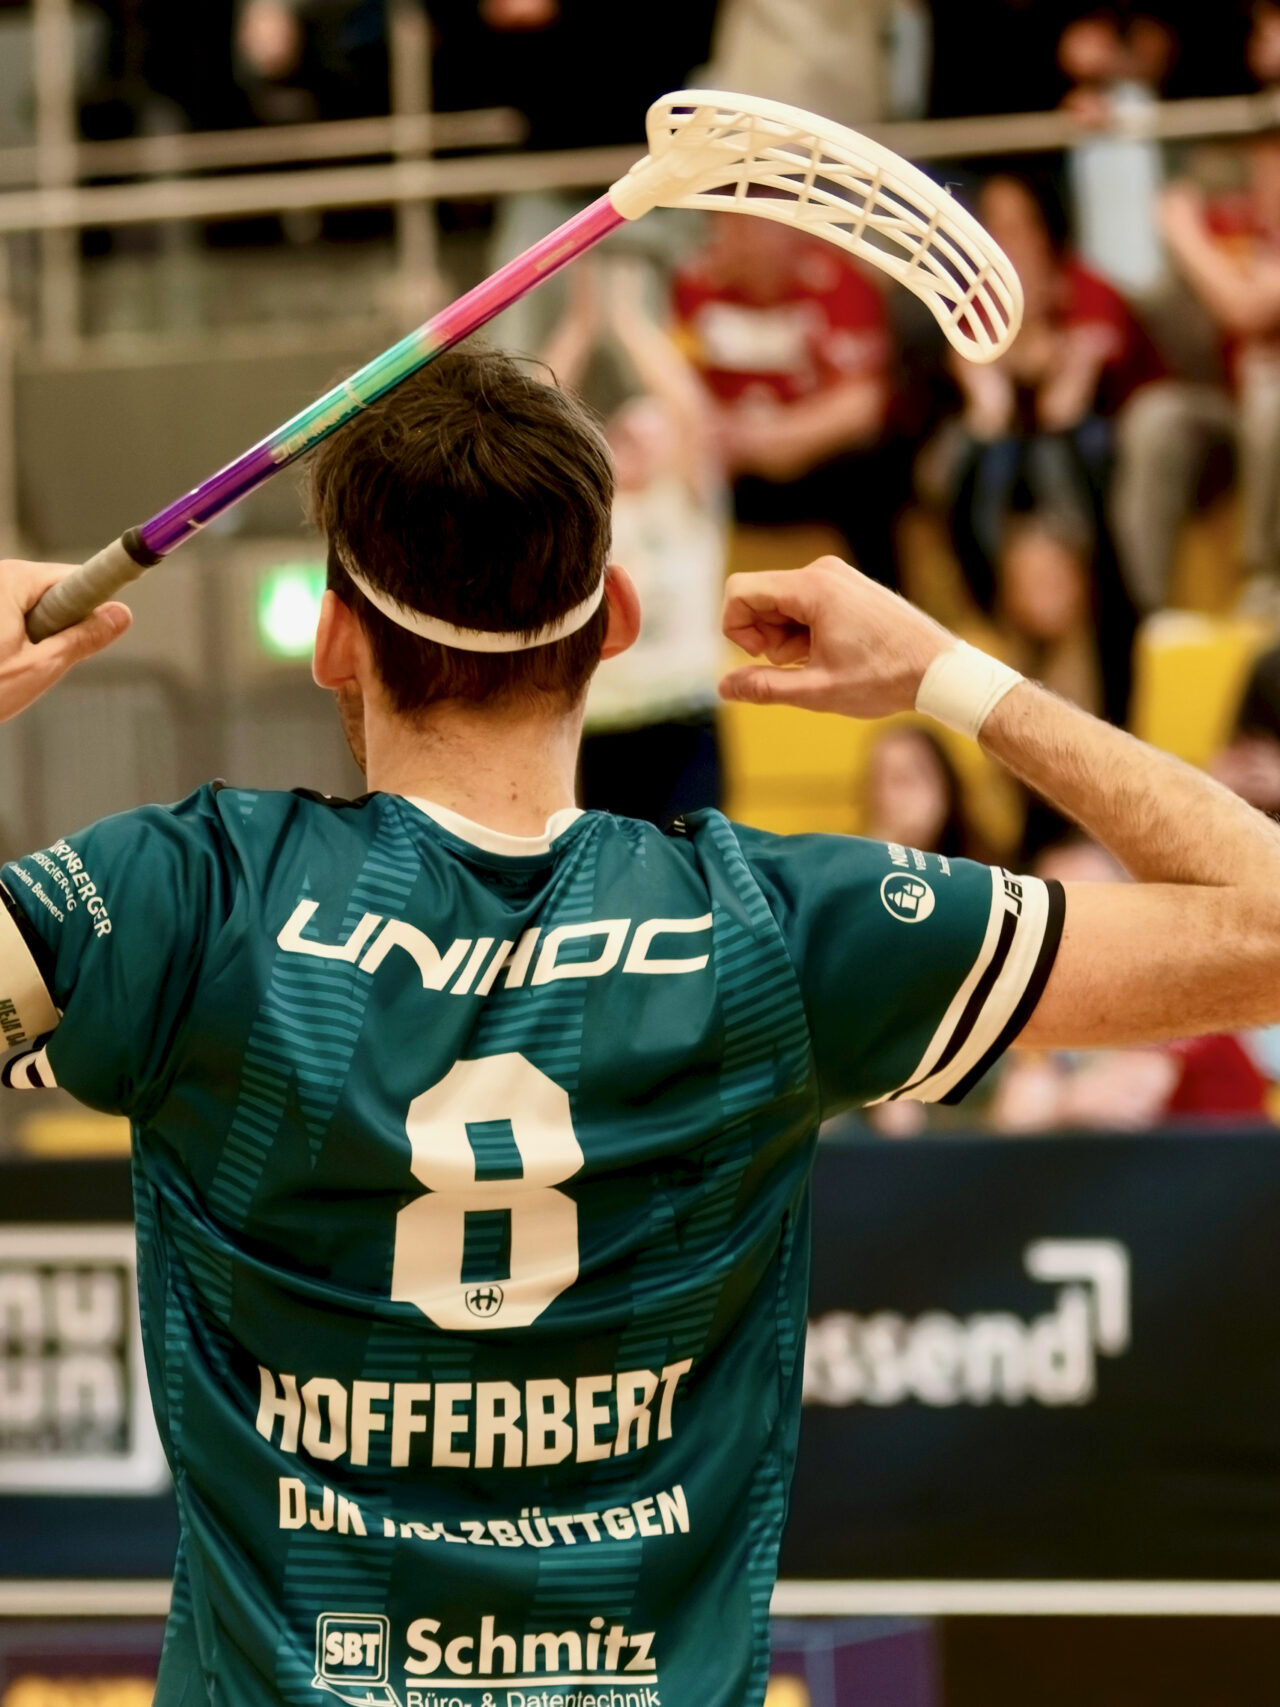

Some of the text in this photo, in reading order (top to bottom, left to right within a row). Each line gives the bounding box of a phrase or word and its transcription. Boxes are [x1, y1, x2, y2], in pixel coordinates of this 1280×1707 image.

[31, 880, 65, 924] Beumers
[276, 899, 713, 997] UNIHOC
[390, 1052, 585, 1331] 8
[255, 1357, 693, 1469] HOFFERBERT
[279, 1477, 367, 1537] DJK
[325, 1631, 380, 1667] SBT
[403, 1615, 657, 1676] Schmitz
